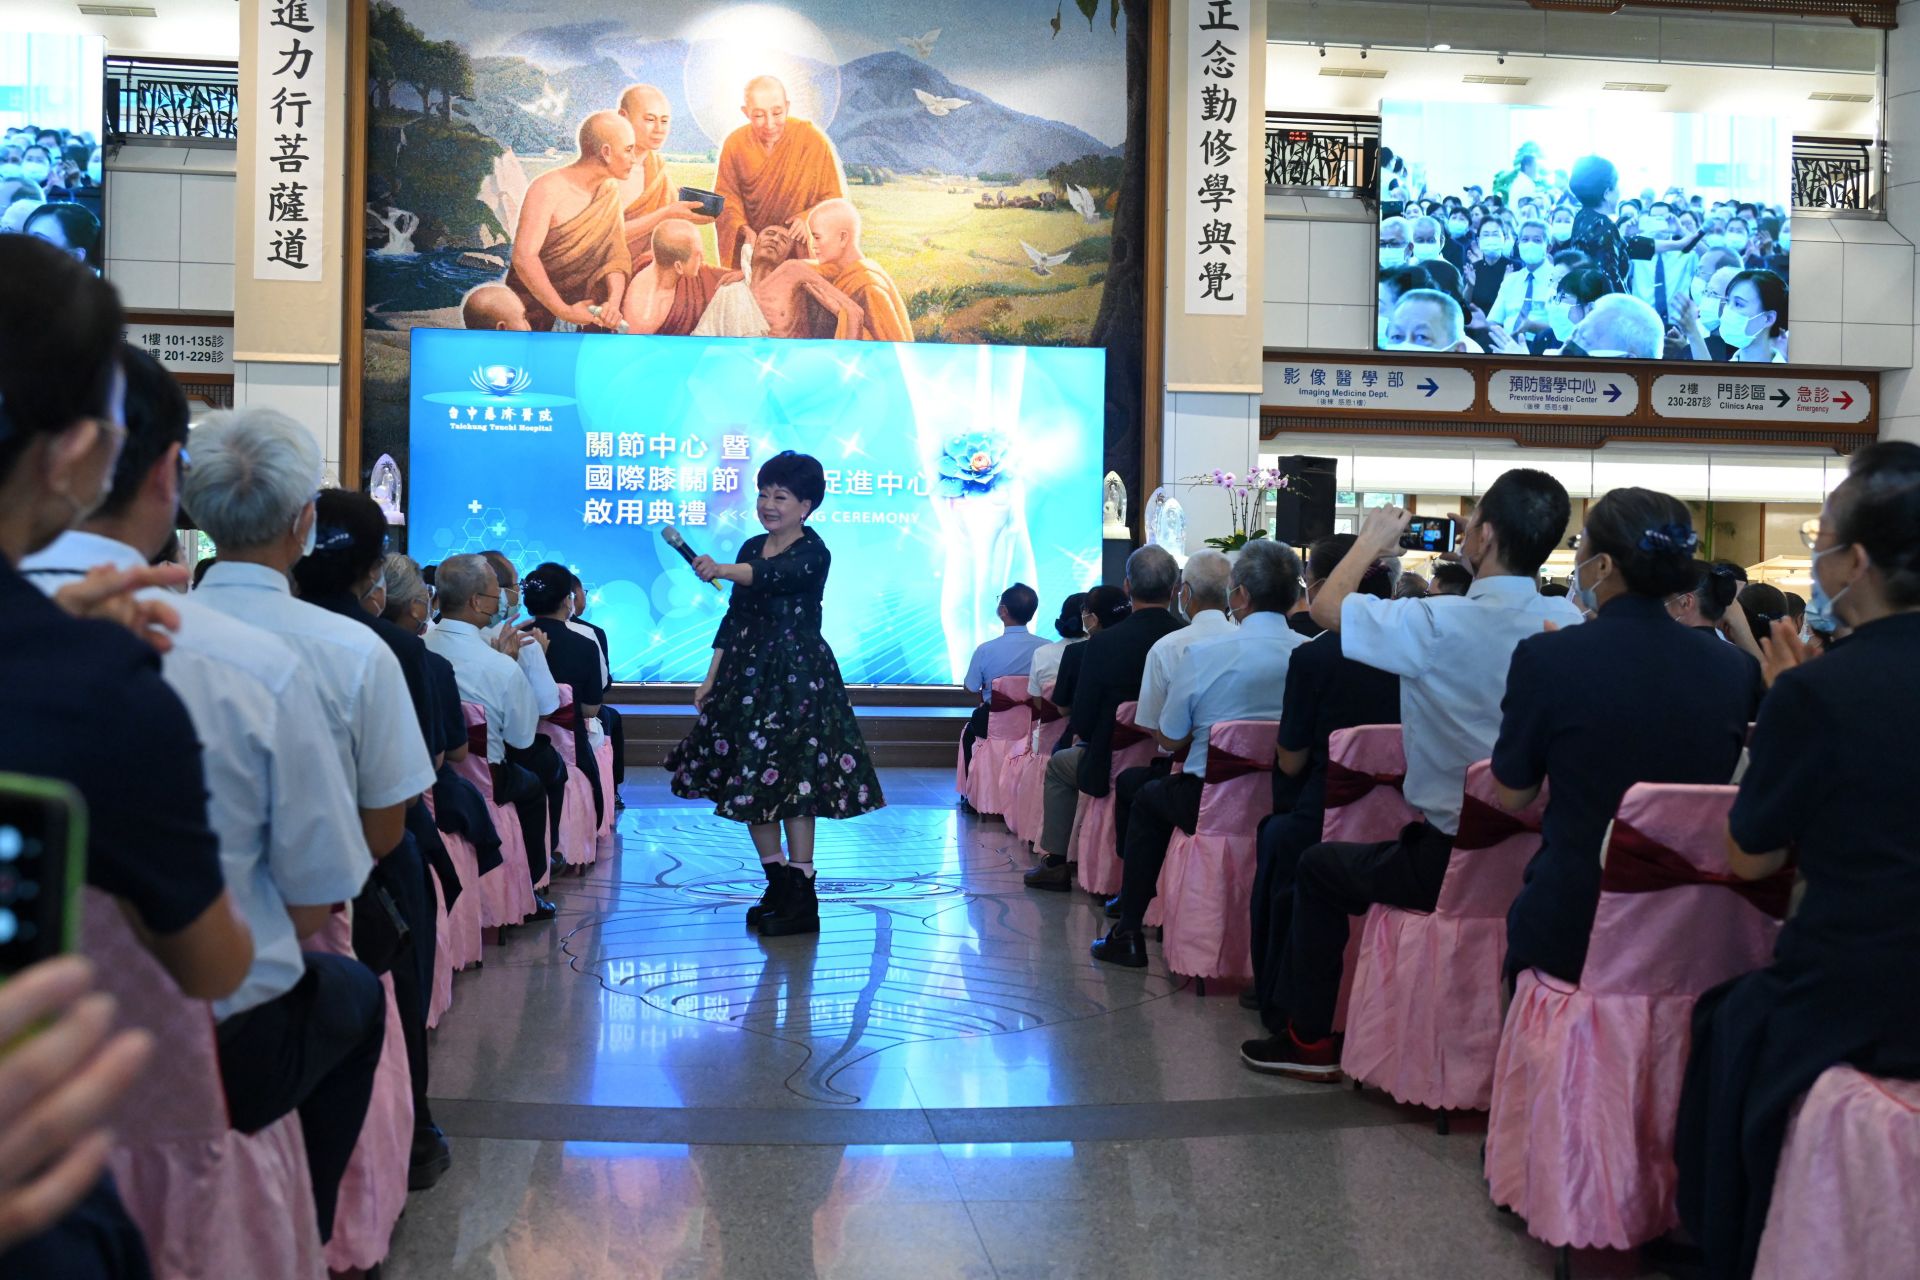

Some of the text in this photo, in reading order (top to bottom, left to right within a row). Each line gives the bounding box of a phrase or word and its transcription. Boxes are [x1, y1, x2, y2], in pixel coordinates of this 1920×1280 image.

[267, 0, 315, 270] 進力行菩薩道
[1198, 0, 1240, 302] 正念勤修學與覺
[142, 333, 161, 346] 1樓
[165, 335, 224, 348] 101-135診
[164, 350, 224, 363] 201-229診
[1283, 367, 1404, 388] 影像醫學部
[1509, 375, 1597, 394] 預防醫學中心
[1299, 388, 1389, 399] Imaging Medicine Dept.
[1679, 383, 1699, 395] 2樓
[1717, 383, 1766, 400] 門診區
[1797, 386, 1830, 403] 急診
[1509, 394, 1598, 403] Preventive Medicine Center
[1667, 396, 1712, 408] 230-287診
[1719, 401, 1764, 411] Clinics Area
[1796, 404, 1830, 414] Emergency
[585, 431, 750, 460] 關節中心 暨
[585, 464, 740, 494] 國際膝關節
[583, 498, 708, 527] 啟用典禮
[831, 511, 920, 525] CEREMONY
